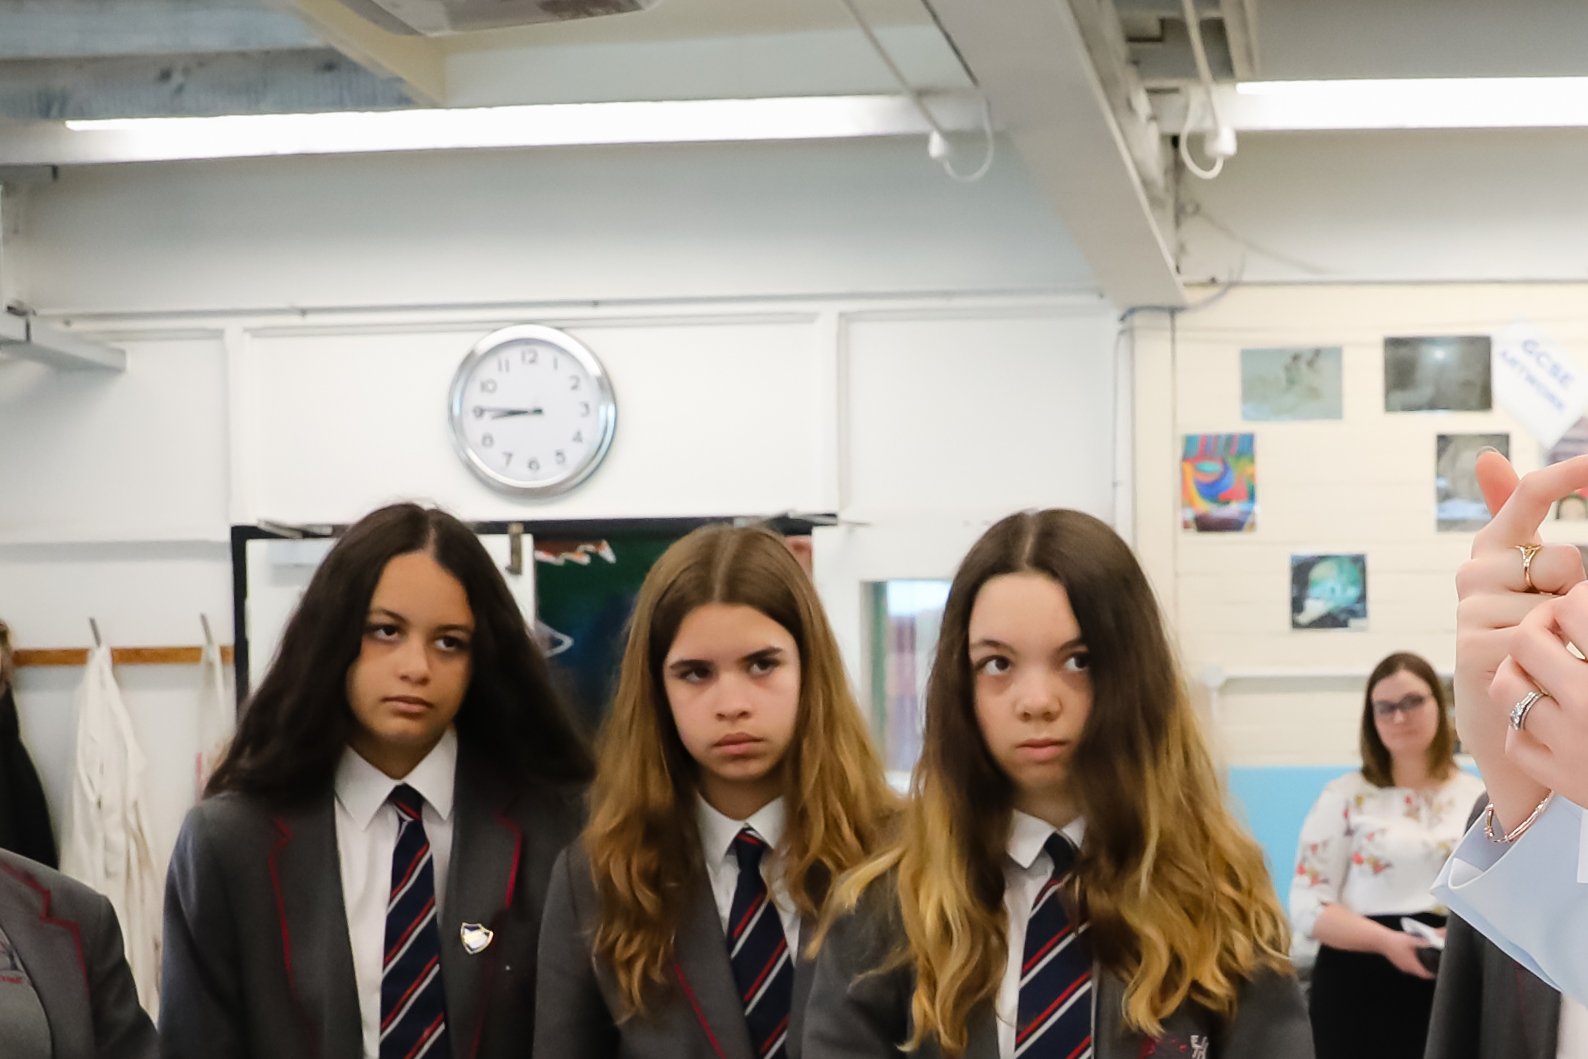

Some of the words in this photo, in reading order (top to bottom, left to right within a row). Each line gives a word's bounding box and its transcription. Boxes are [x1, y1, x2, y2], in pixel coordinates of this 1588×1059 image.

[521, 349, 538, 364] 12
[498, 359, 510, 373] 11
[553, 357, 558, 371] 1
[480, 379, 497, 393] 10
[569, 375, 581, 391] 2
[580, 401, 590, 417] 3
[482, 432, 494, 447] 8
[572, 429, 584, 443] 4
[503, 451, 513, 466] 7
[527, 457, 541, 471] 6
[555, 450, 566, 464] 5
